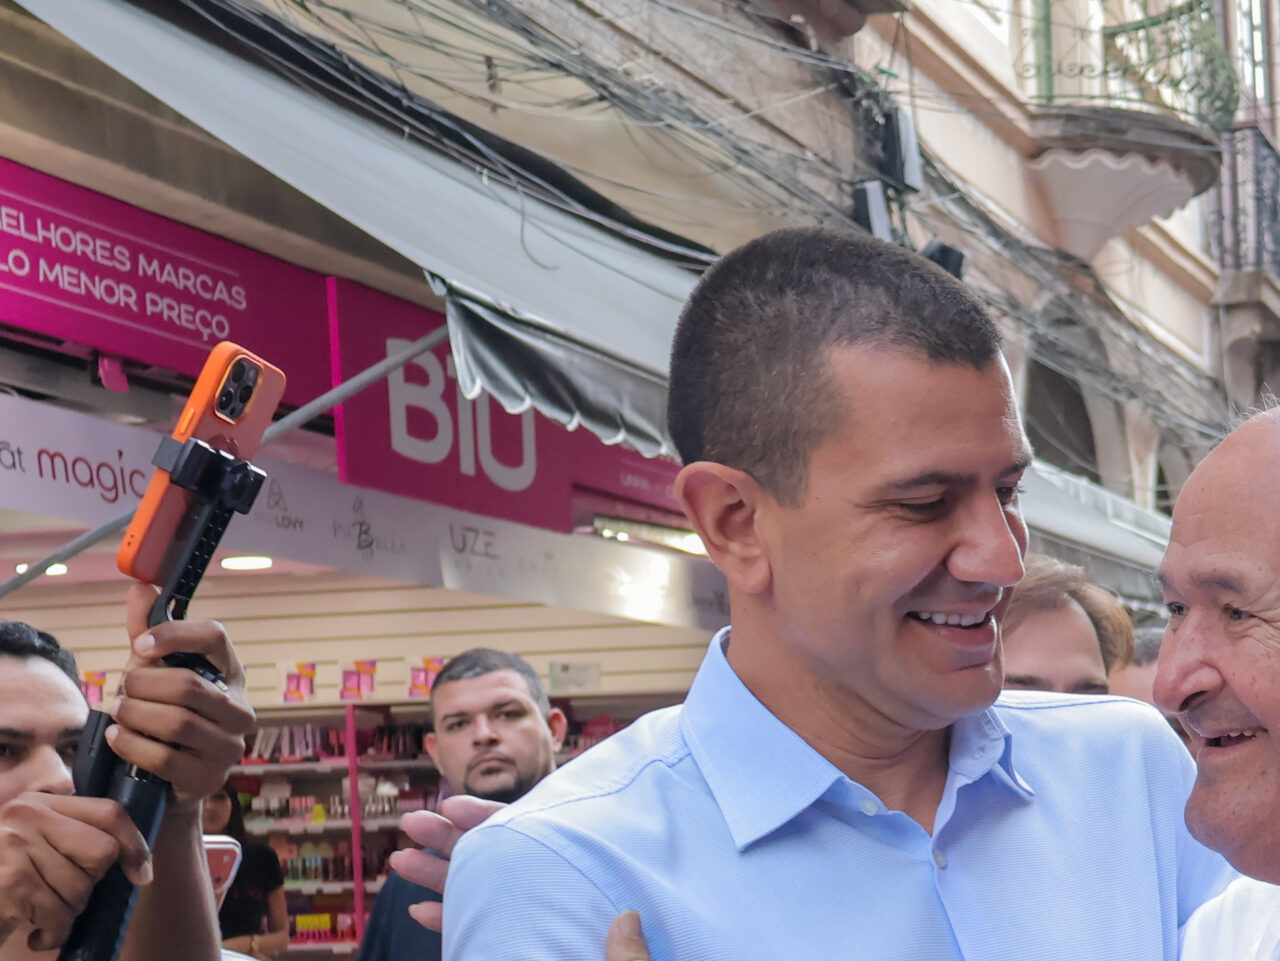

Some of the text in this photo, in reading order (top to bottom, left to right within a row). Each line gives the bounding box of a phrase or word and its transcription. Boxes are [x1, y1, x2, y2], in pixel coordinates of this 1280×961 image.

[0, 206, 247, 310] ELHORES MARCAS
[39, 258, 138, 312] MENOR
[146, 292, 230, 341] PREÇO
